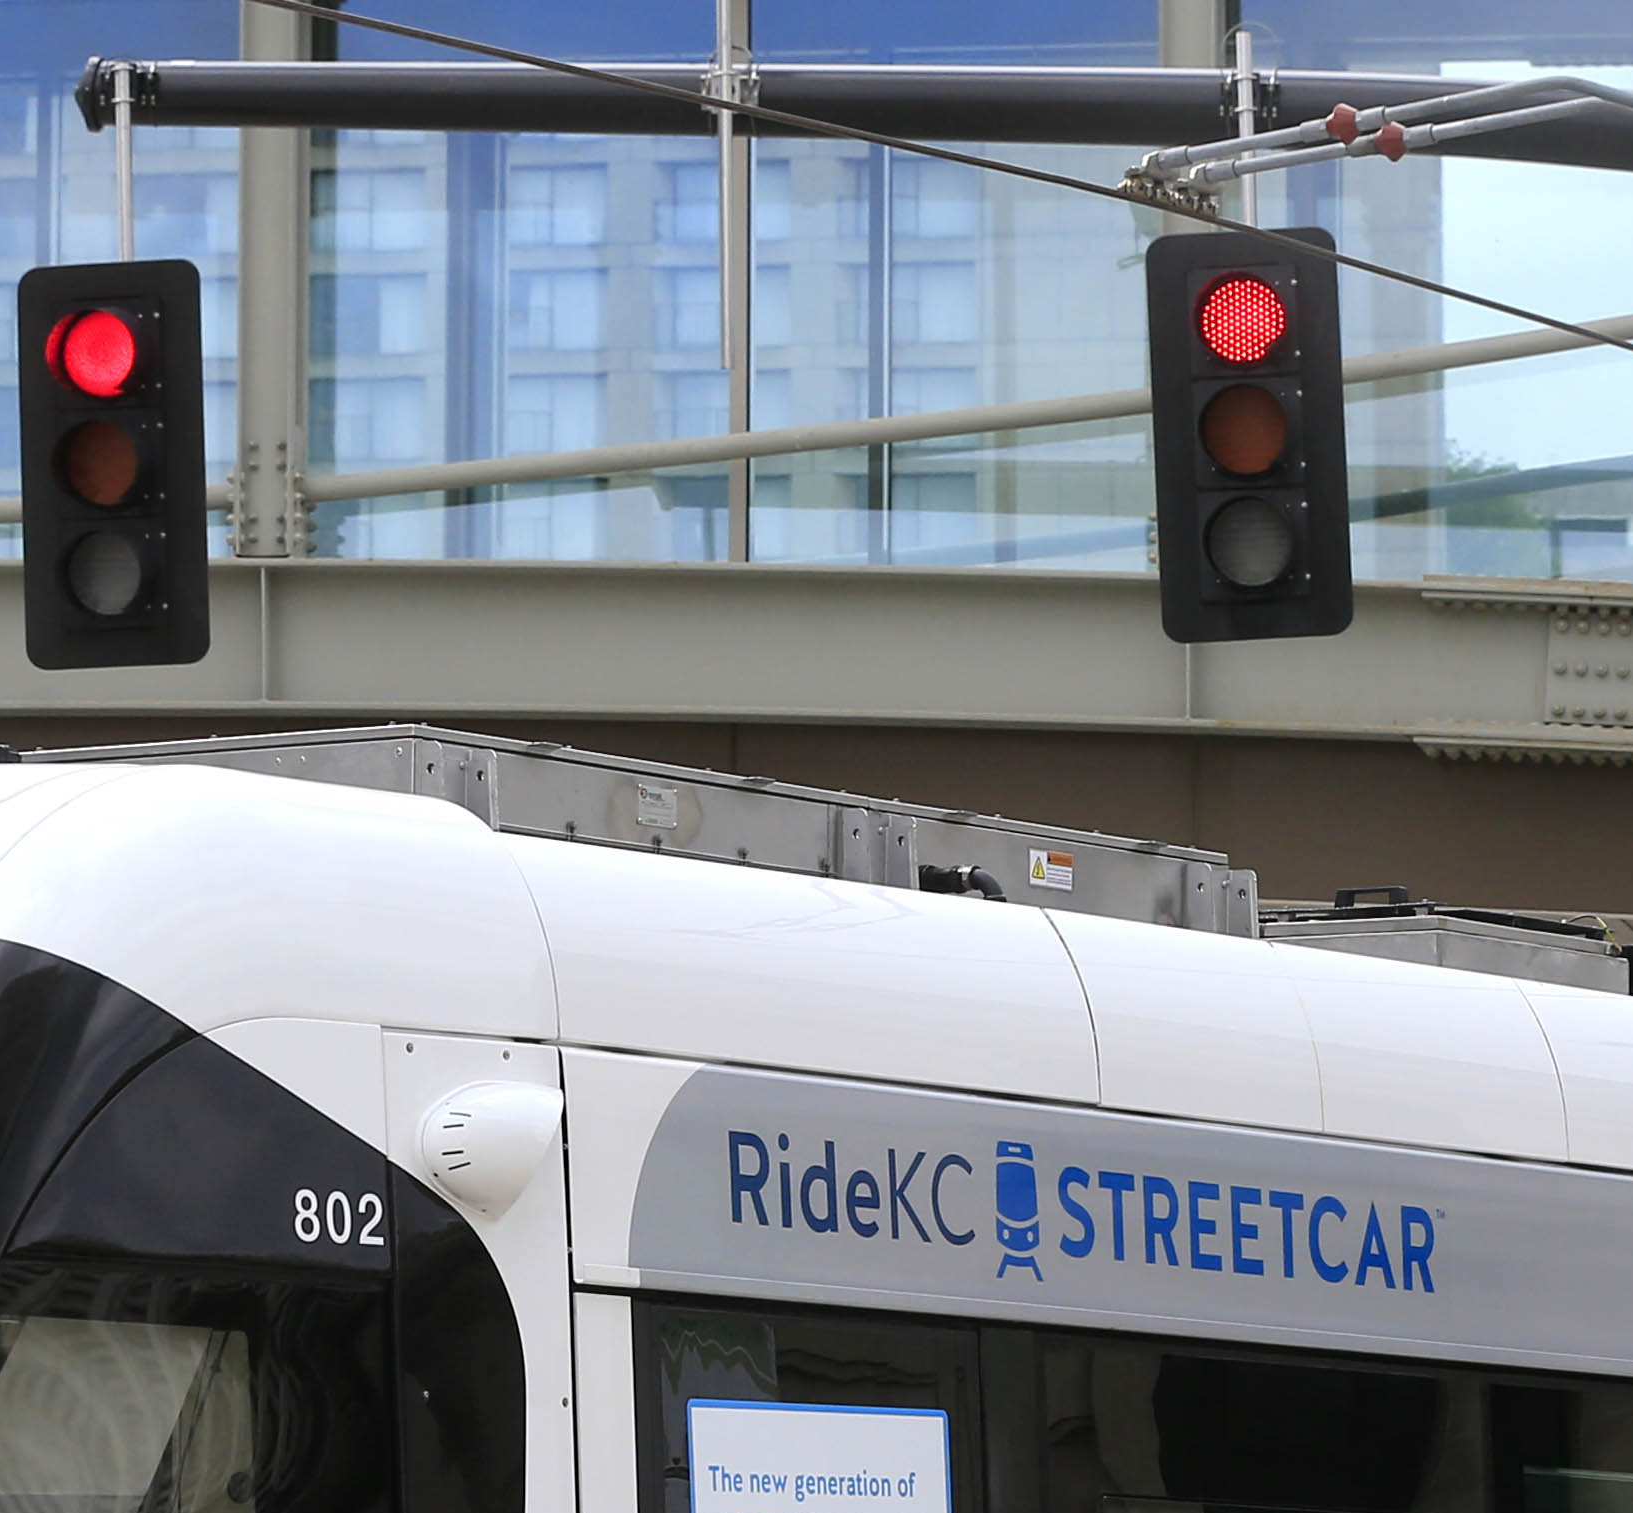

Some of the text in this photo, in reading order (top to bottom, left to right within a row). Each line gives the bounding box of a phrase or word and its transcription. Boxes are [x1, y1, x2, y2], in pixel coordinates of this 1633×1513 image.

[294, 1188, 385, 1246] 802
[727, 1129, 977, 1247] RideKC
[1059, 1166, 1436, 1294] STREETCAR
[707, 1464, 916, 1503] The new generation of
